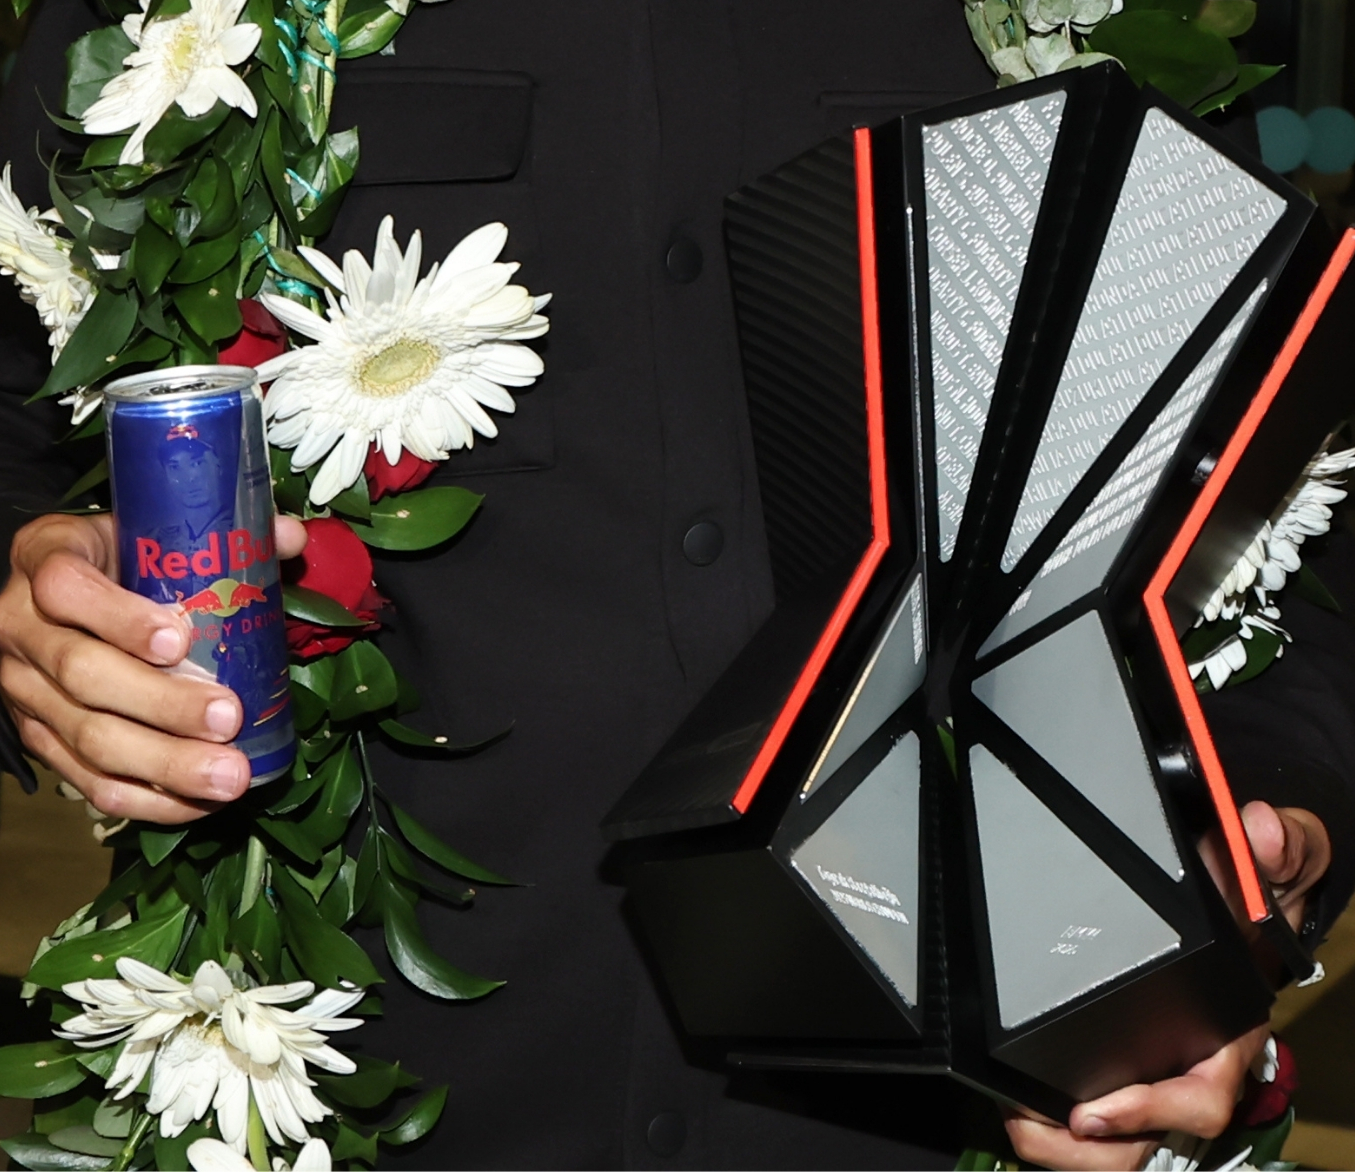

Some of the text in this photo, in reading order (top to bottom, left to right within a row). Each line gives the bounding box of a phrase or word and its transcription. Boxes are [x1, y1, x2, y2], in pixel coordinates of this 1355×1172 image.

[988, 120, 1033, 178] MERKEL
[1137, 169, 1199, 205] HONDA
[1134, 197, 1196, 236] DUCATI
[1151, 220, 1214, 260] DUCATI
[1211, 197, 1276, 237] DUCATI
[1138, 256, 1200, 294] DUCATI
[1124, 291, 1186, 329] DUCATI
[1076, 339, 1136, 375] DUCATI
[136, 531, 222, 580] Red
[191, 622, 233, 642] RGY
